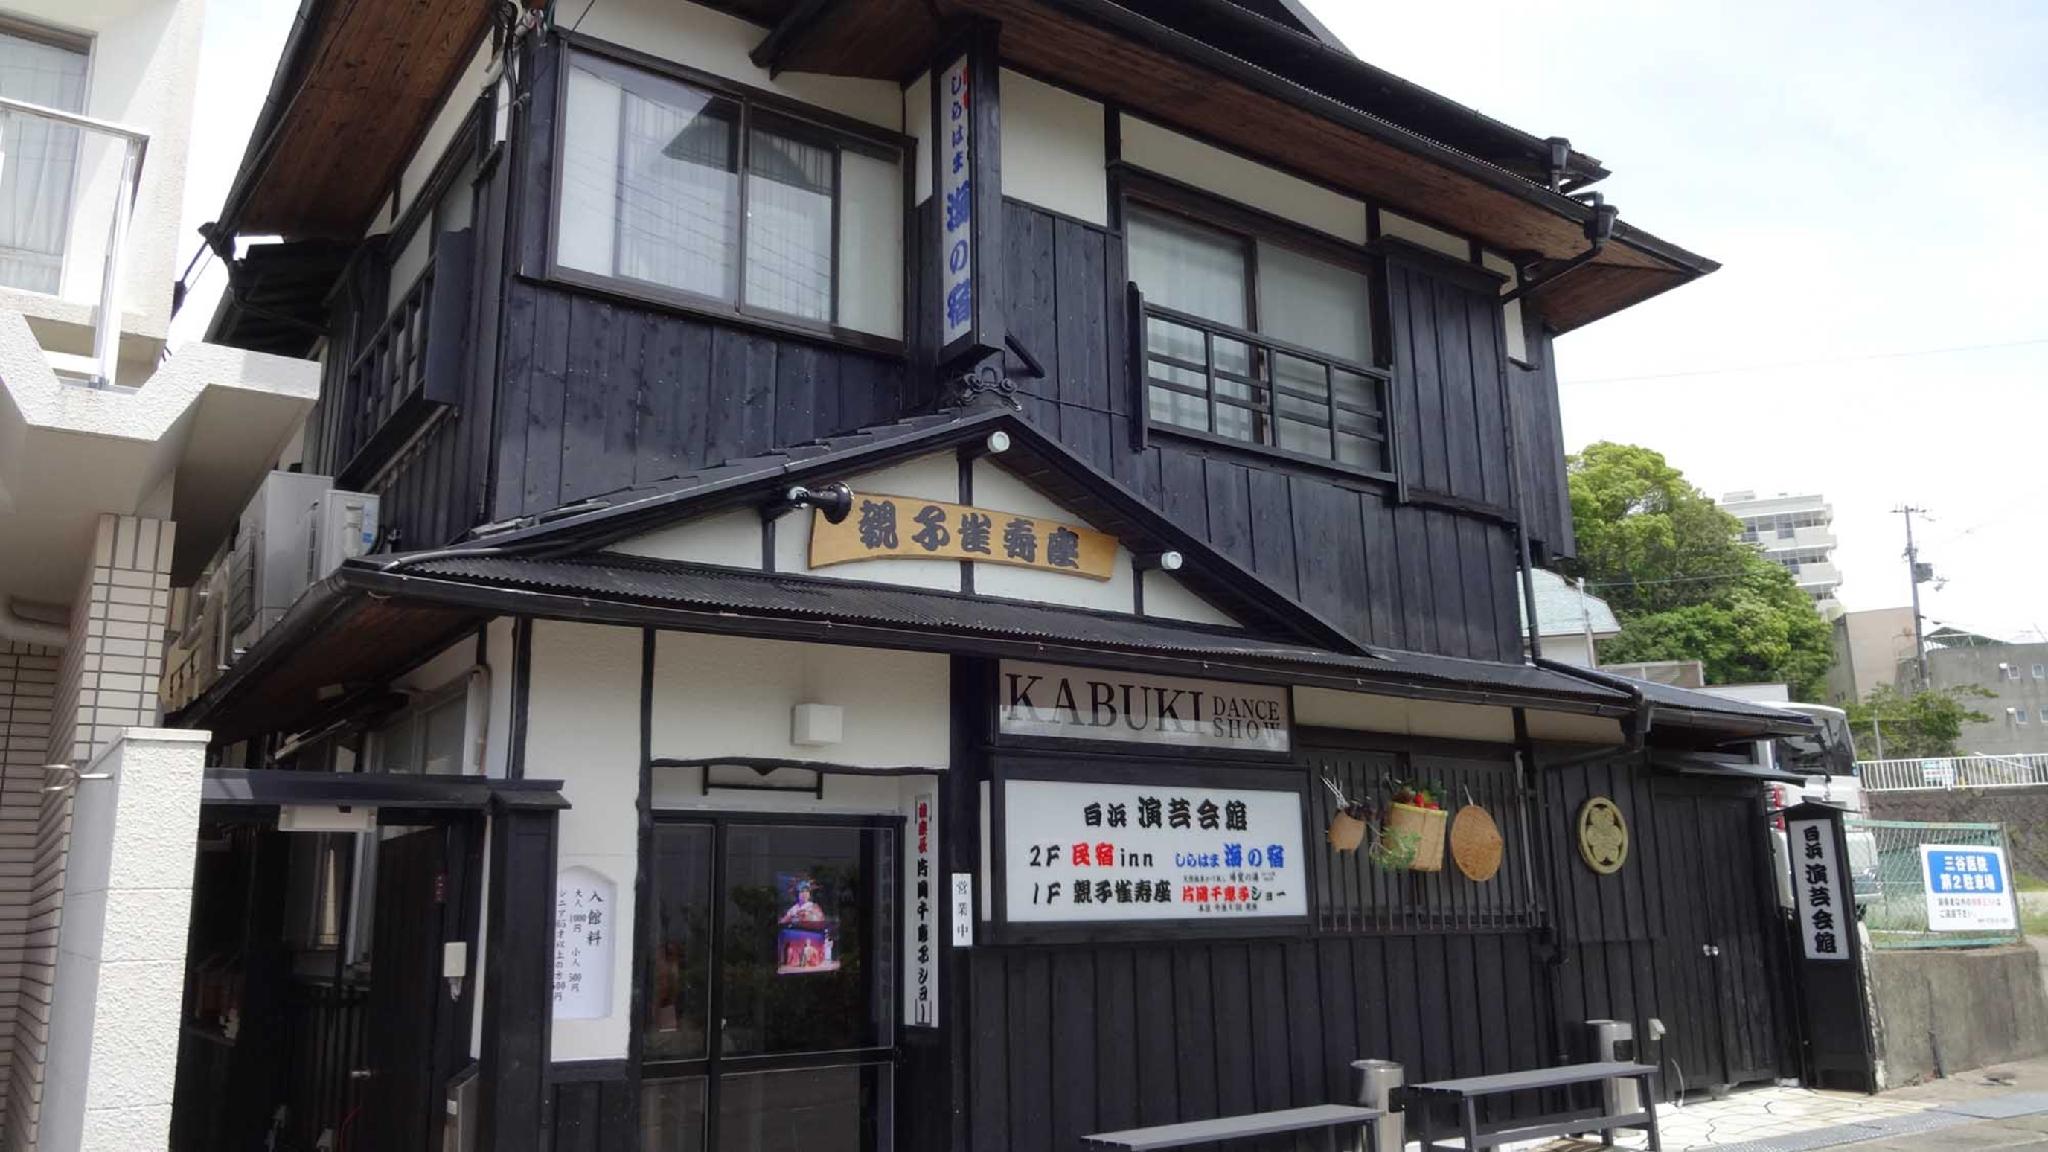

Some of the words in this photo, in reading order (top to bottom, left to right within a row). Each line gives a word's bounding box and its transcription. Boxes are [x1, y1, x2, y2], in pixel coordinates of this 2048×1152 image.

[1004, 673, 1205, 734] KABUKI
[1212, 695, 1280, 721] DANCE
[1213, 717, 1281, 740] SHOW
[1030, 845, 1061, 867] 2F
[1033, 882, 1061, 904] 1F
[587, 889, 604, 946] 入館料
[956, 879, 969, 938] 営業中
